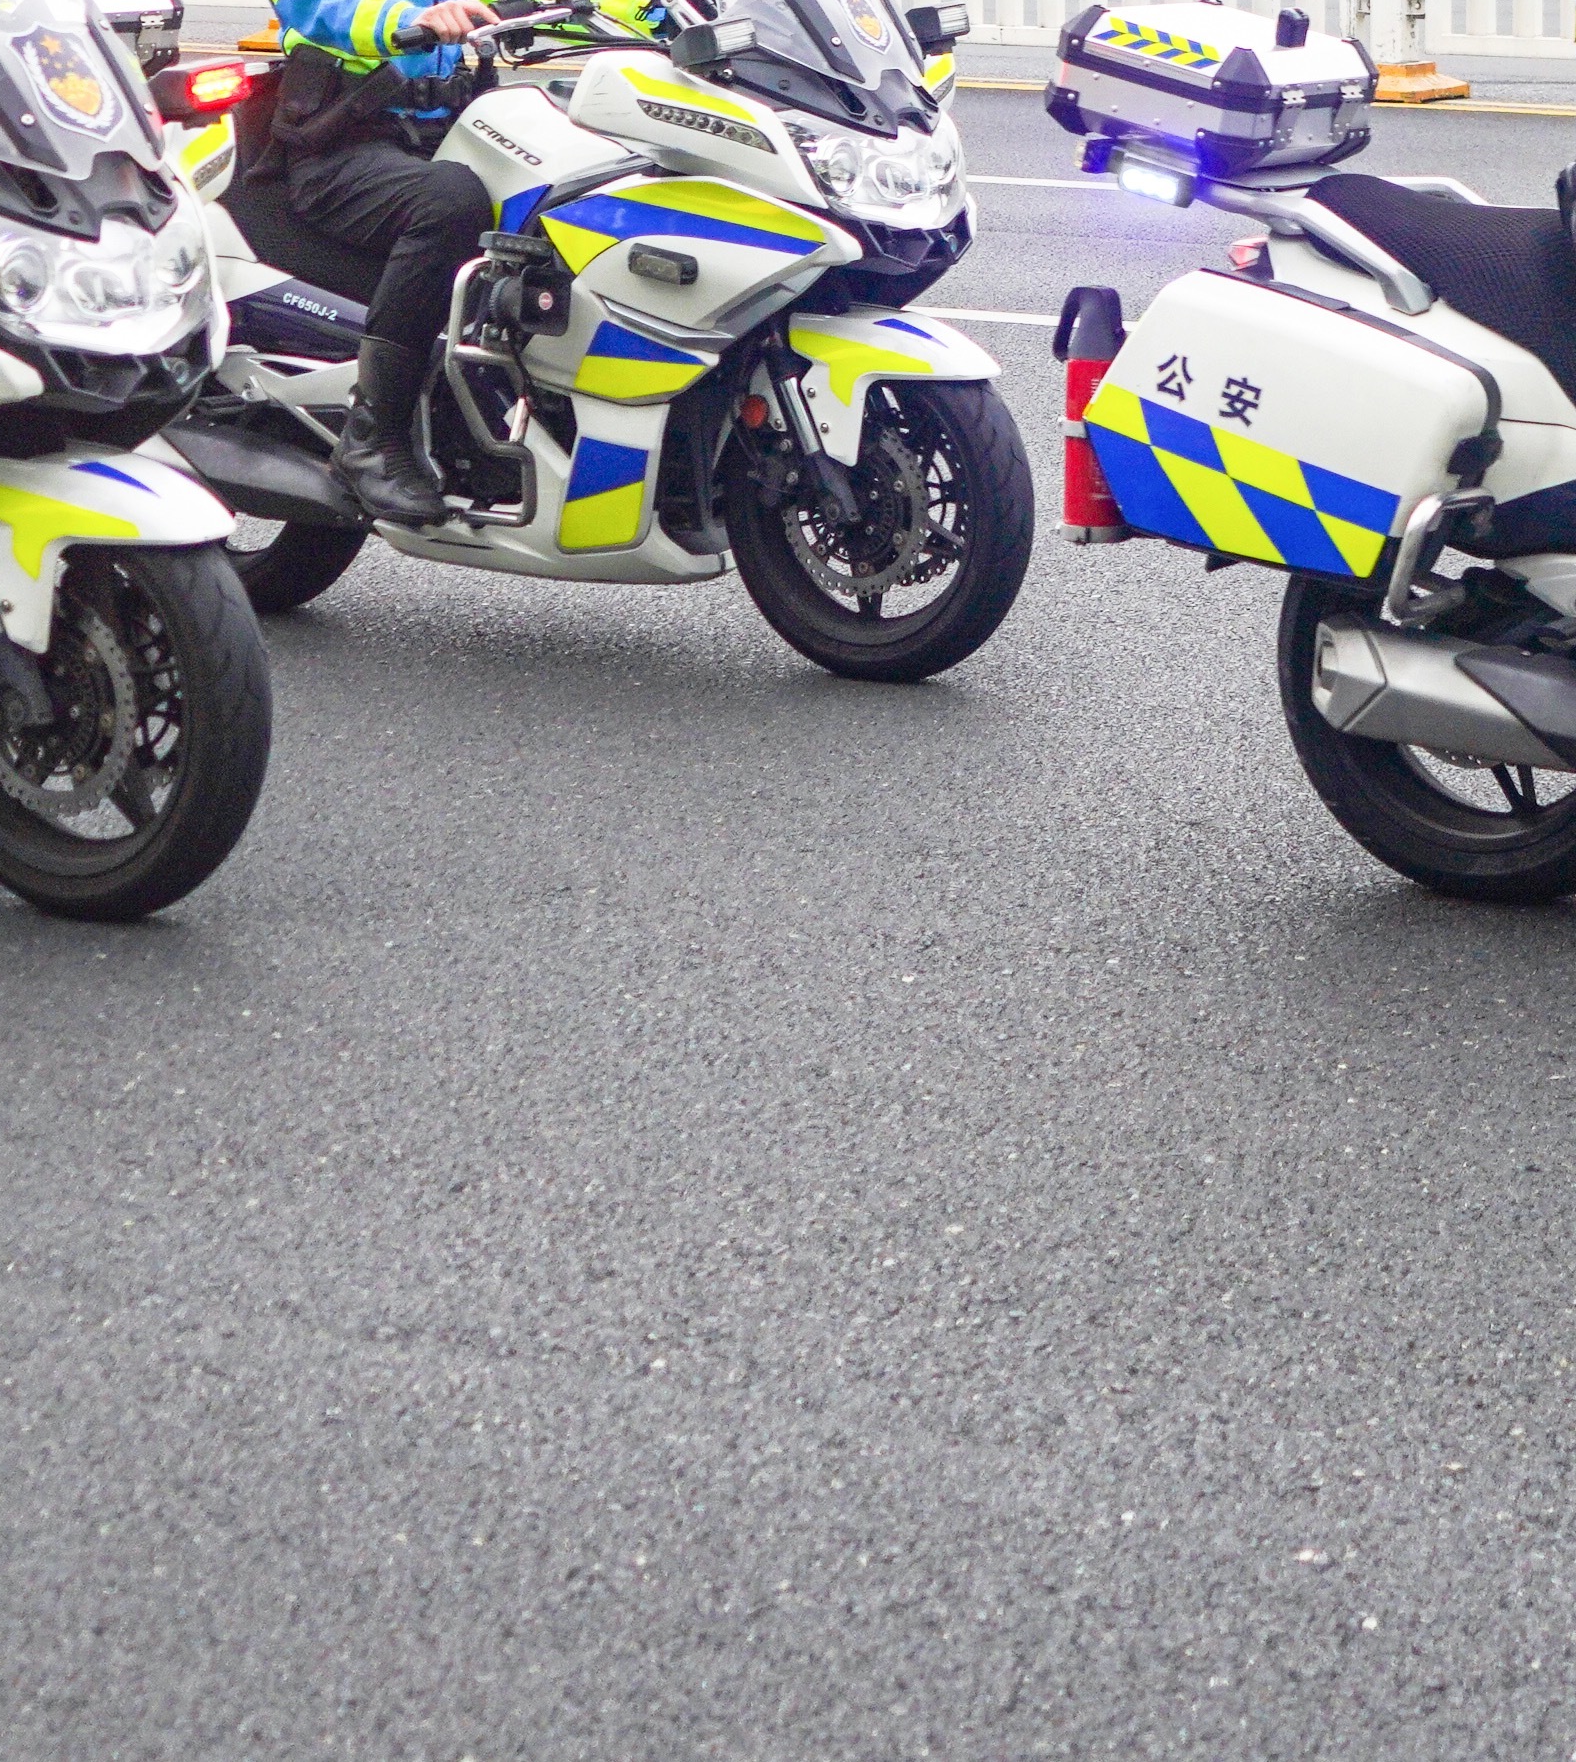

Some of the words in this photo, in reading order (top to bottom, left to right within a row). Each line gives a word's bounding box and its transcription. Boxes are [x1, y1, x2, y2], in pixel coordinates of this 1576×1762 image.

[472, 119, 543, 166] CFMOTO
[283, 292, 338, 321] CF650J-2
[1157, 354, 1262, 427] 公安
